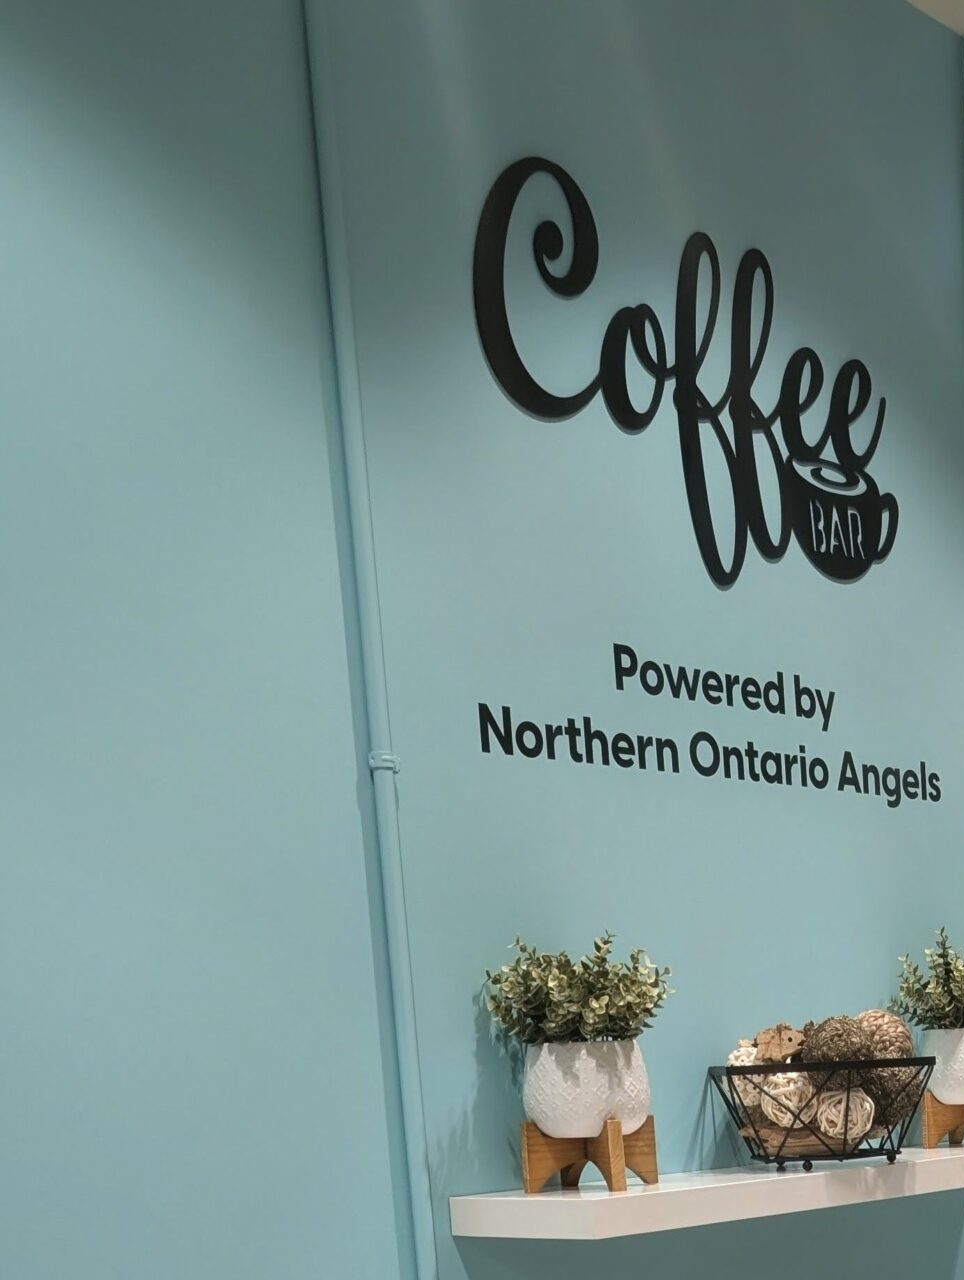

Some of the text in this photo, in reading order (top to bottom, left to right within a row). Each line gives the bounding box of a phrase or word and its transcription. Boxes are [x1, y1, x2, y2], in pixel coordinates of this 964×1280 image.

[473, 156, 888, 592] Coffee
[810, 499, 866, 559] BAR
[613, 643, 835, 731] Powered by
[478, 703, 941, 808] Northern Ontario Angels
